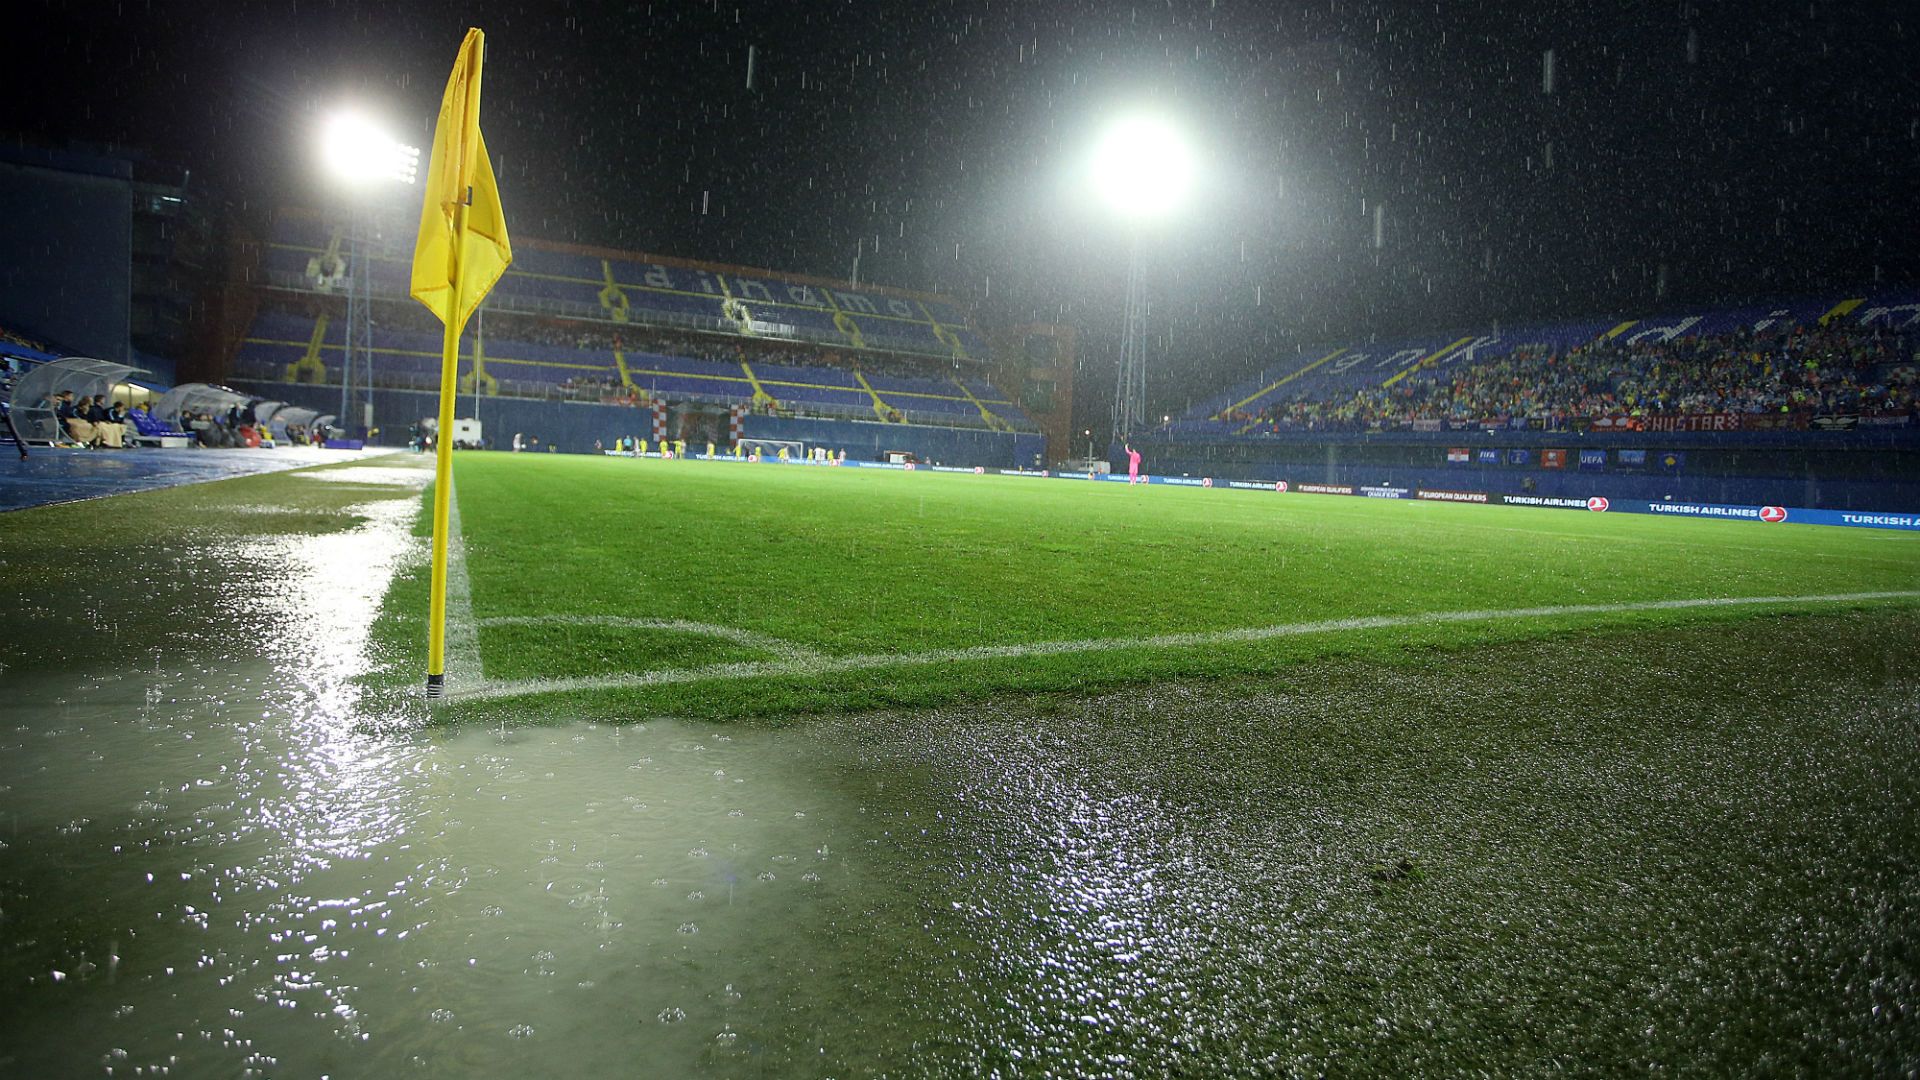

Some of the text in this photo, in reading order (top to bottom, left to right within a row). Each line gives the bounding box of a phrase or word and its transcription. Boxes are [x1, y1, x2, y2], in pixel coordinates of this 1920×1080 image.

[1479, 451, 1495, 459] FIFA
[1580, 456, 1603, 464] UEFA
[1424, 491, 1487, 501] EUROPEAN QUALIFIERS
[1503, 496, 1587, 507] TURKISH AIRLINES
[1649, 503, 1758, 517] TURKISH AIRLINES
[1842, 515, 1911, 526] TURKISH
